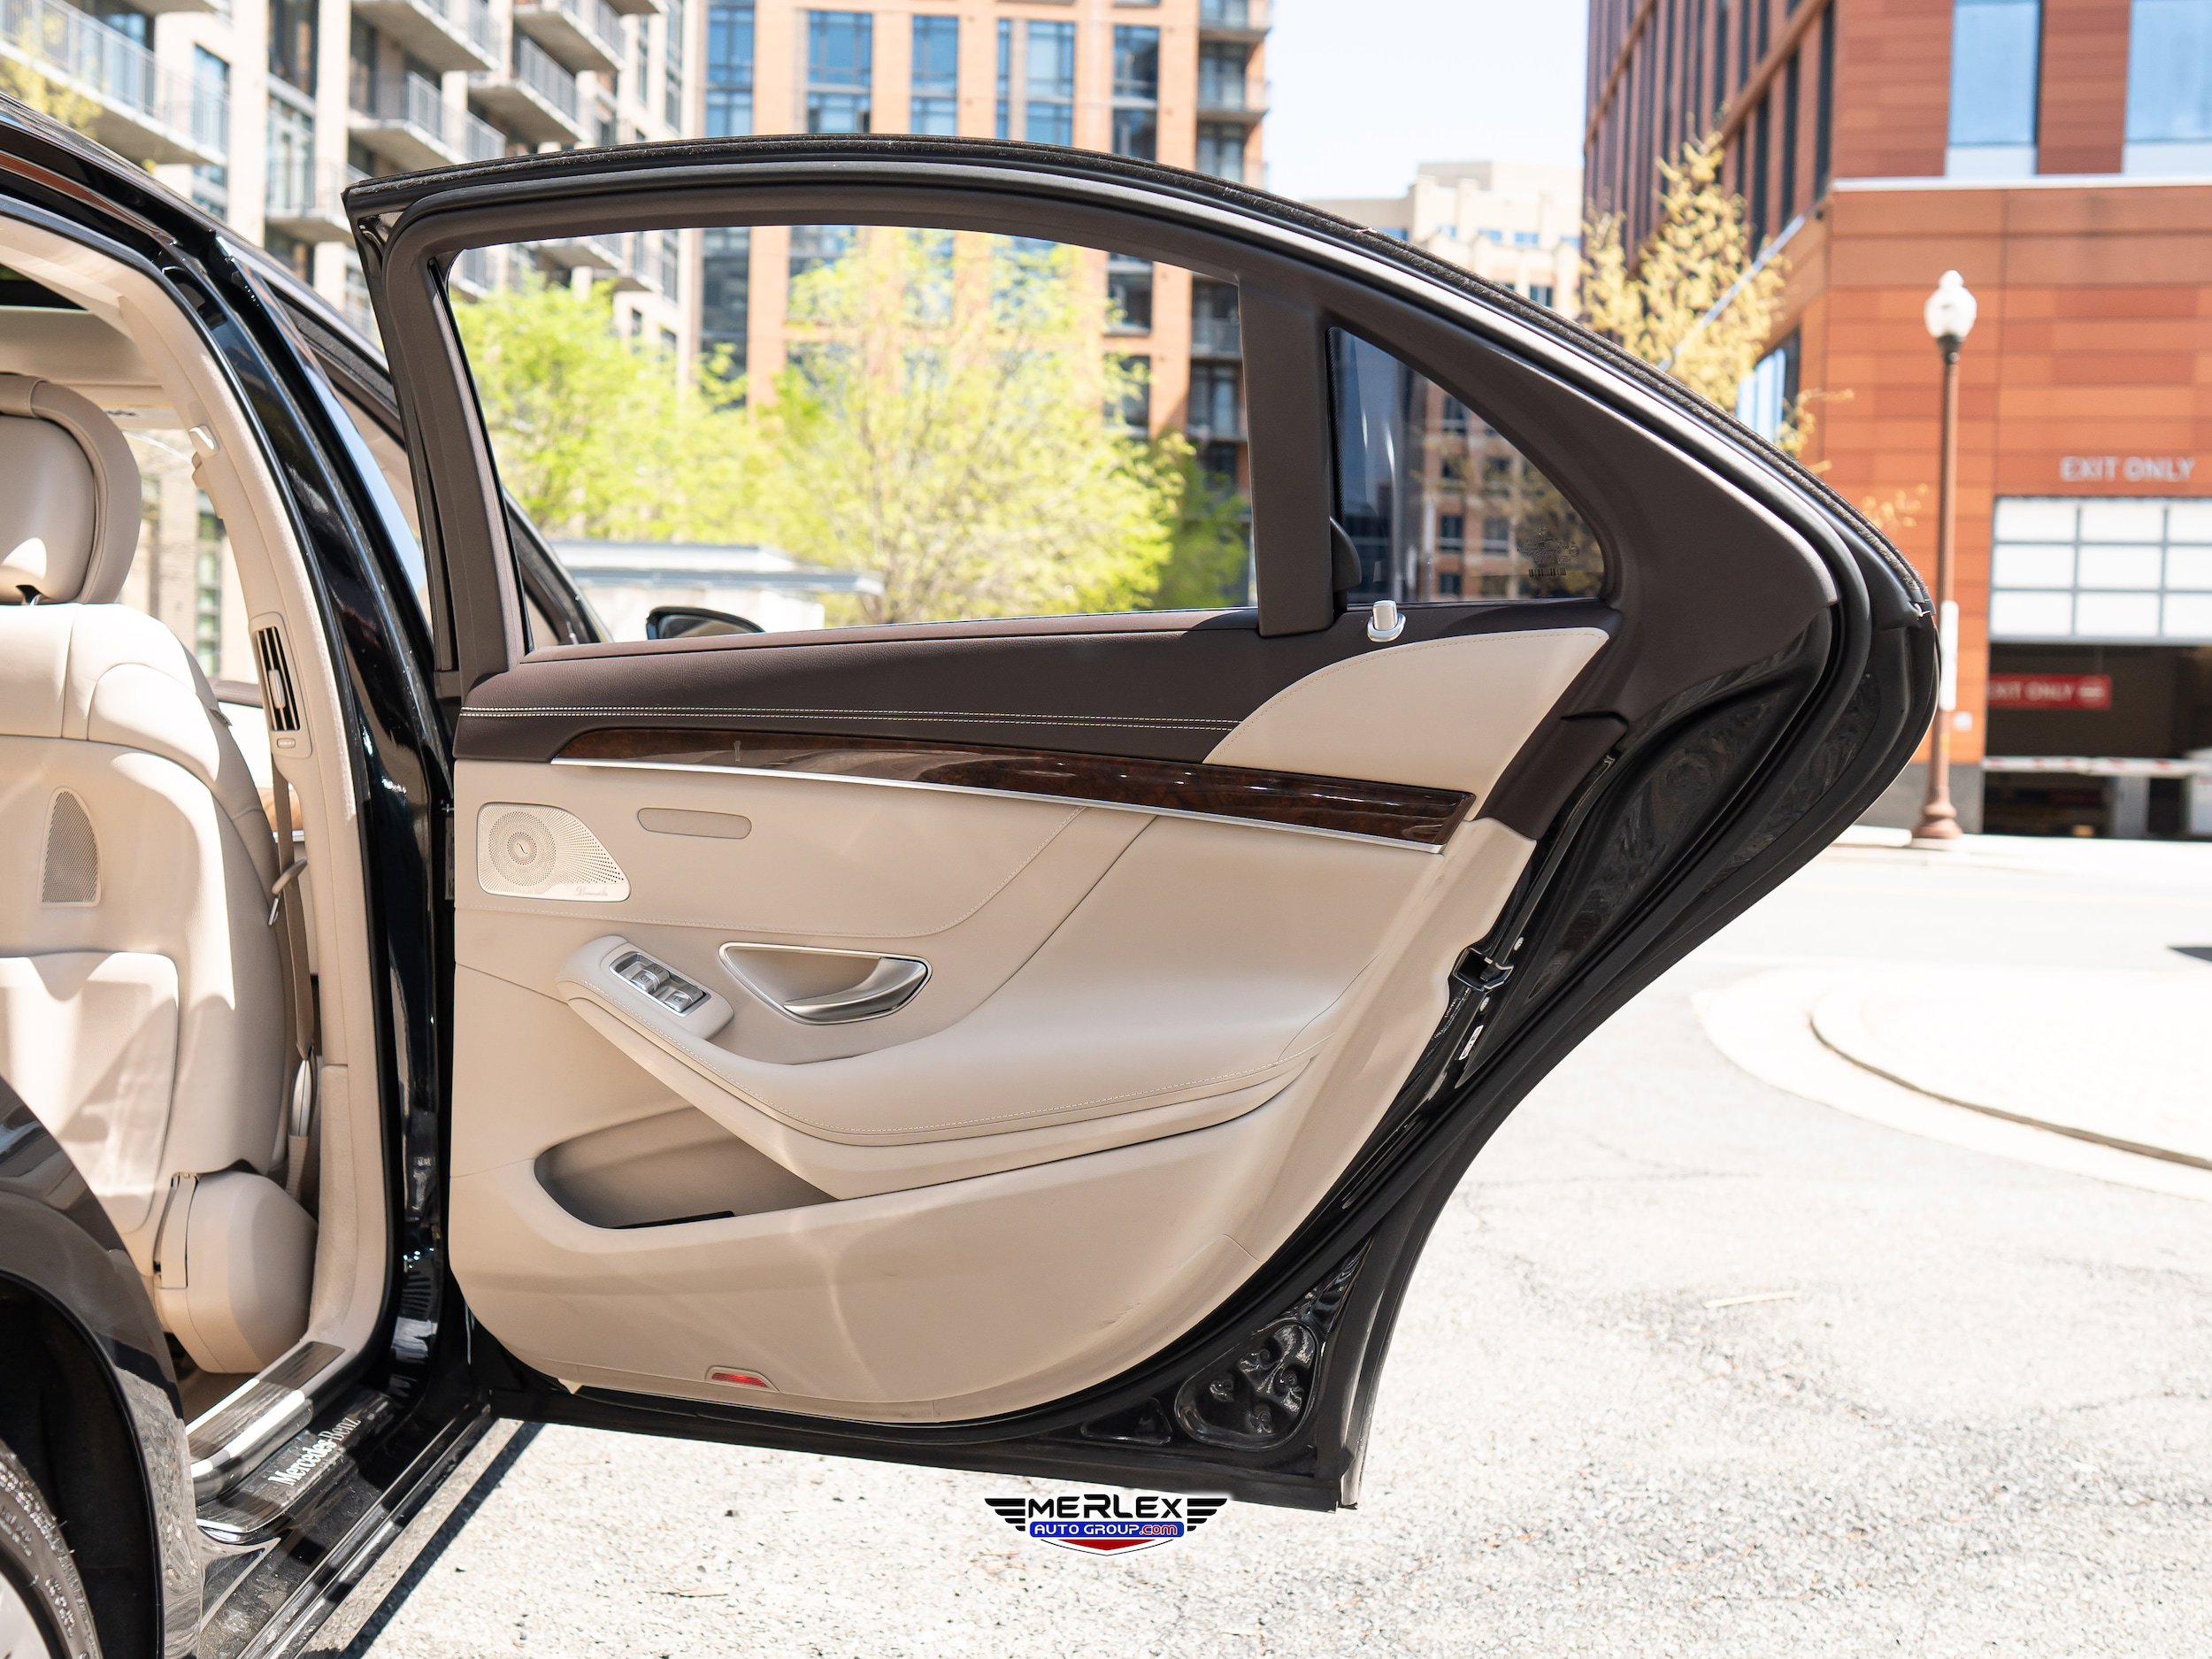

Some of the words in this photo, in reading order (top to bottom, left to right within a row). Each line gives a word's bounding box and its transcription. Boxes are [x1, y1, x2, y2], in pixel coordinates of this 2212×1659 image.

[2060, 456, 2120, 481] EXIT
[2124, 457, 2195, 482] ONLY
[2024, 680, 2075, 702] ONLY
[268, 1417, 362, 1486] Mercedes-Benz
